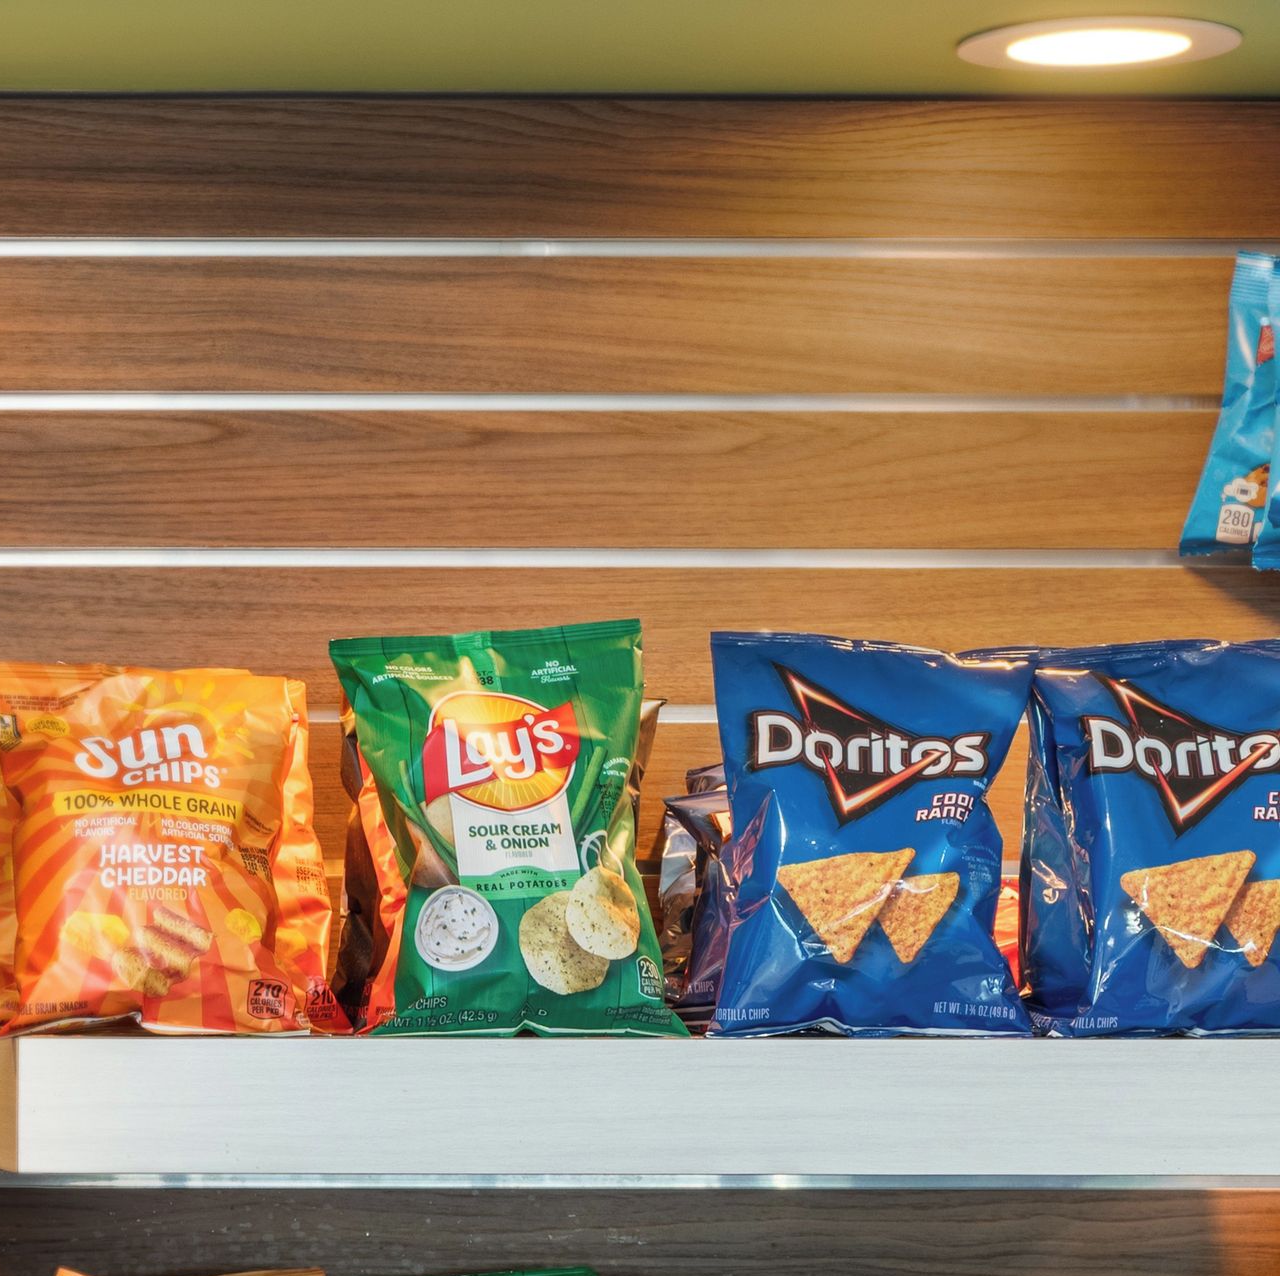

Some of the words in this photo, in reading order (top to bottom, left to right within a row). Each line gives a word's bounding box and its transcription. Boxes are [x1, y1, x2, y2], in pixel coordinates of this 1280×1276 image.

[1222, 509, 1250, 527] 280
[531, 665, 577, 676] ARTIFICIAL
[756, 714, 987, 775] Doritos
[75, 724, 207, 779] Sun
[444, 715, 563, 789] Lay's
[122, 763, 220, 788] CHIPS
[64, 793, 114, 810] 100%
[119, 793, 181, 810] WHOLE
[186, 798, 237, 819] GRAIN
[90, 817, 137, 827] ARTIFICIAL
[161, 819, 175, 827] NO
[176, 820, 210, 832] COLORS
[75, 827, 115, 837] FLAVORS
[161, 829, 207, 841] ARTIFICIAL
[469, 825, 510, 837] SOUR
[513, 823, 562, 835] CREAM
[486, 839, 497, 850] &
[501, 837, 549, 849] ONION
[99, 844, 204, 867] HARVEST
[100, 867, 207, 888] CHEDDAR
[476, 883, 504, 891] REAL
[510, 879, 567, 889] POTATOES
[129, 888, 188, 901] FLAVORED
[253, 982, 282, 998] 210
[35, 1004, 57, 1015] GRAIN
[415, 997, 447, 1010] CHIPS
[934, 1002, 947, 1013] NET
[949, 1003, 962, 1014] WT.
[458, 1010, 485, 1022] (42.5
[749, 1008, 769, 1019] CHIPS
[1097, 1016, 1118, 1028] CHIPS
